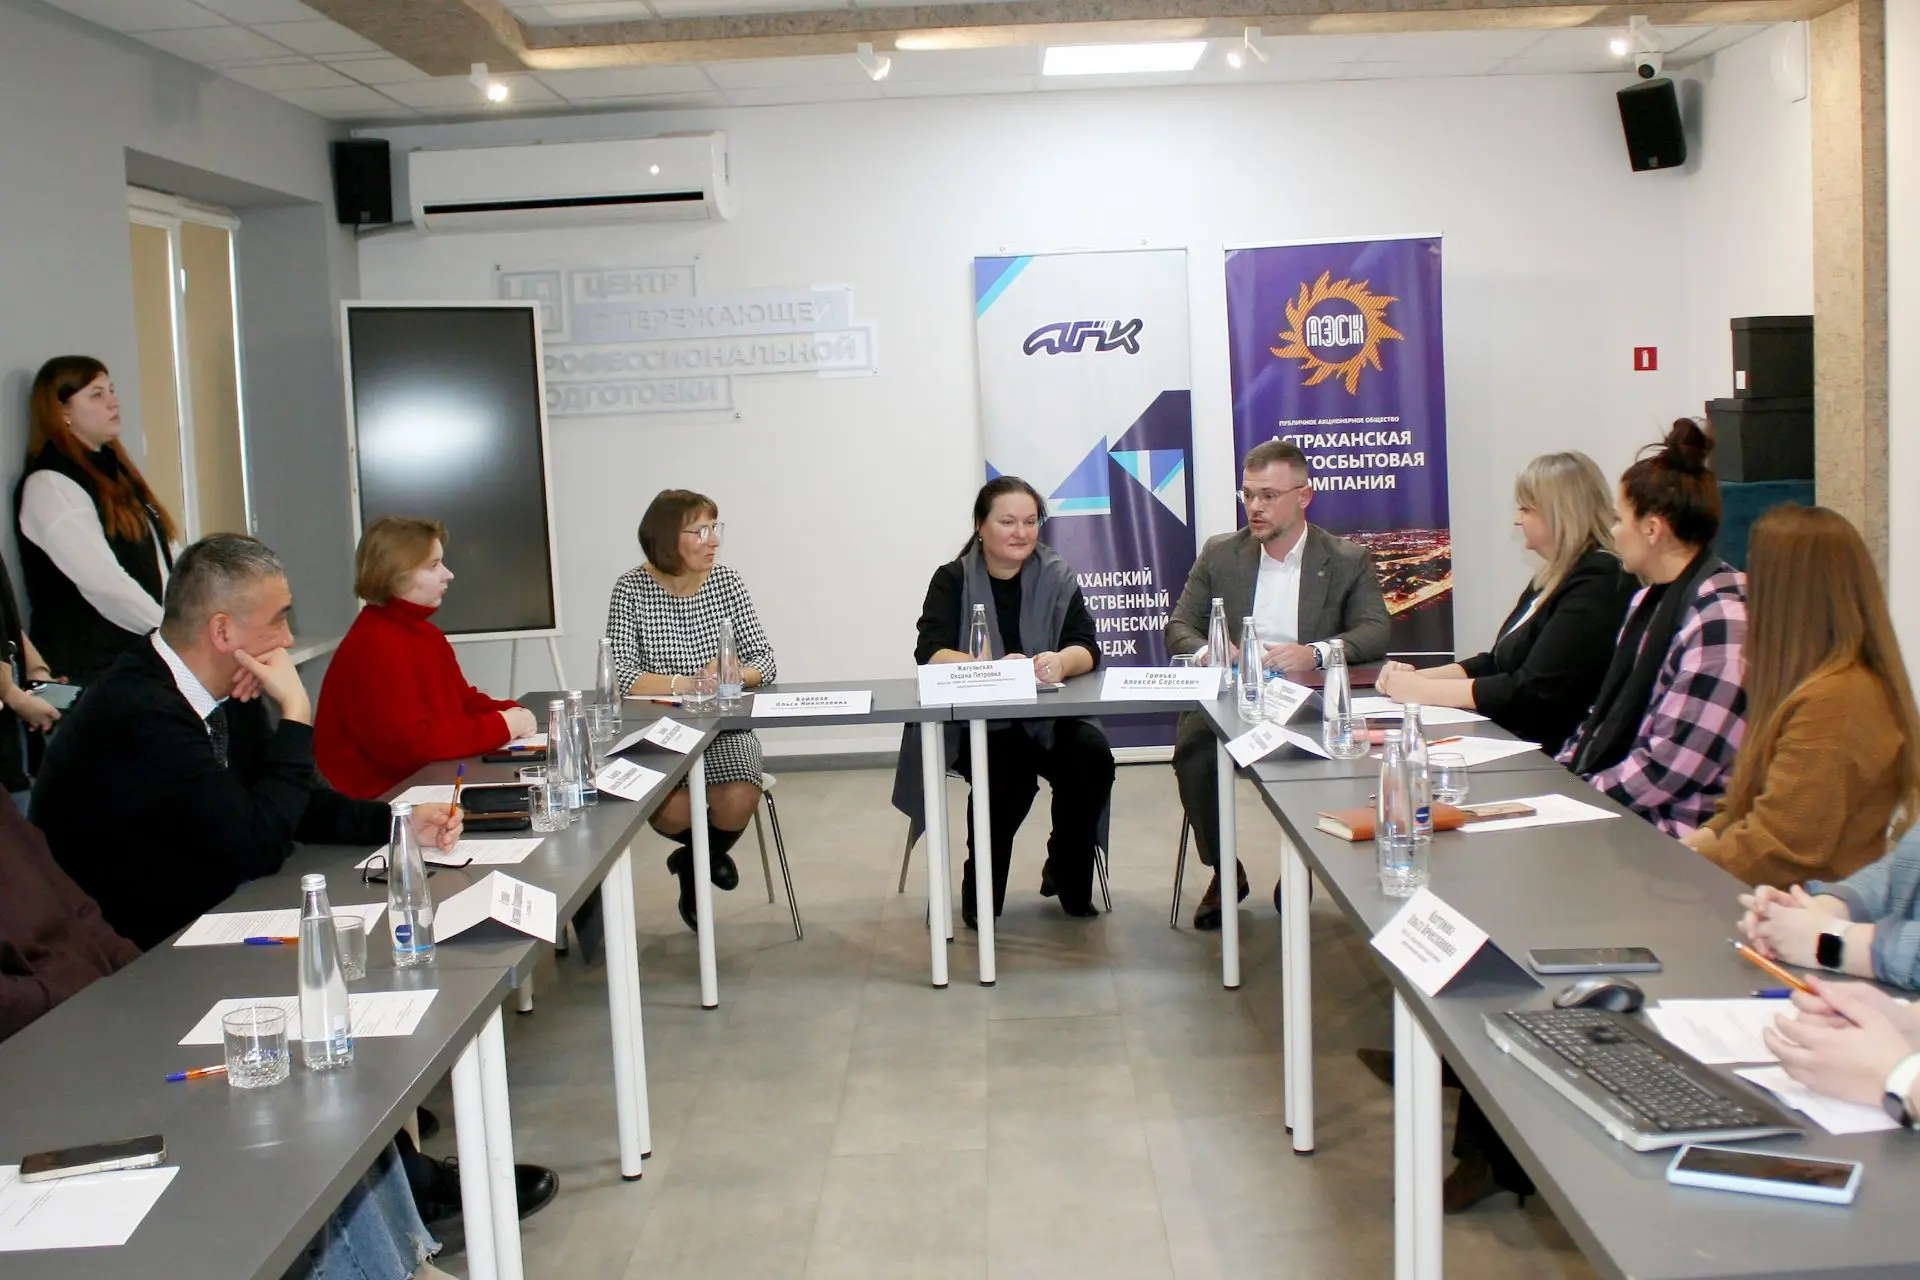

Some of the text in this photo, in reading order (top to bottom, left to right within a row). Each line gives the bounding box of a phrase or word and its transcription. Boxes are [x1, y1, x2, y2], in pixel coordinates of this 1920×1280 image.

[583, 272, 678, 298] ЦЕНТР
[1306, 314, 1364, 347] АЭСК
[543, 334, 857, 376] РОФЕССИОНАЛЬНОЙ
[545, 380, 718, 411] ОДГОТОВКИ
[1318, 417, 1364, 426] АКЦИОНЕРНОЕ
[1365, 416, 1400, 424] ОБЩЕСТВО
[1305, 452, 1425, 470] ГОСБЫТОВАЯ
[1076, 567, 1152, 588] АХАНСКИЙ
